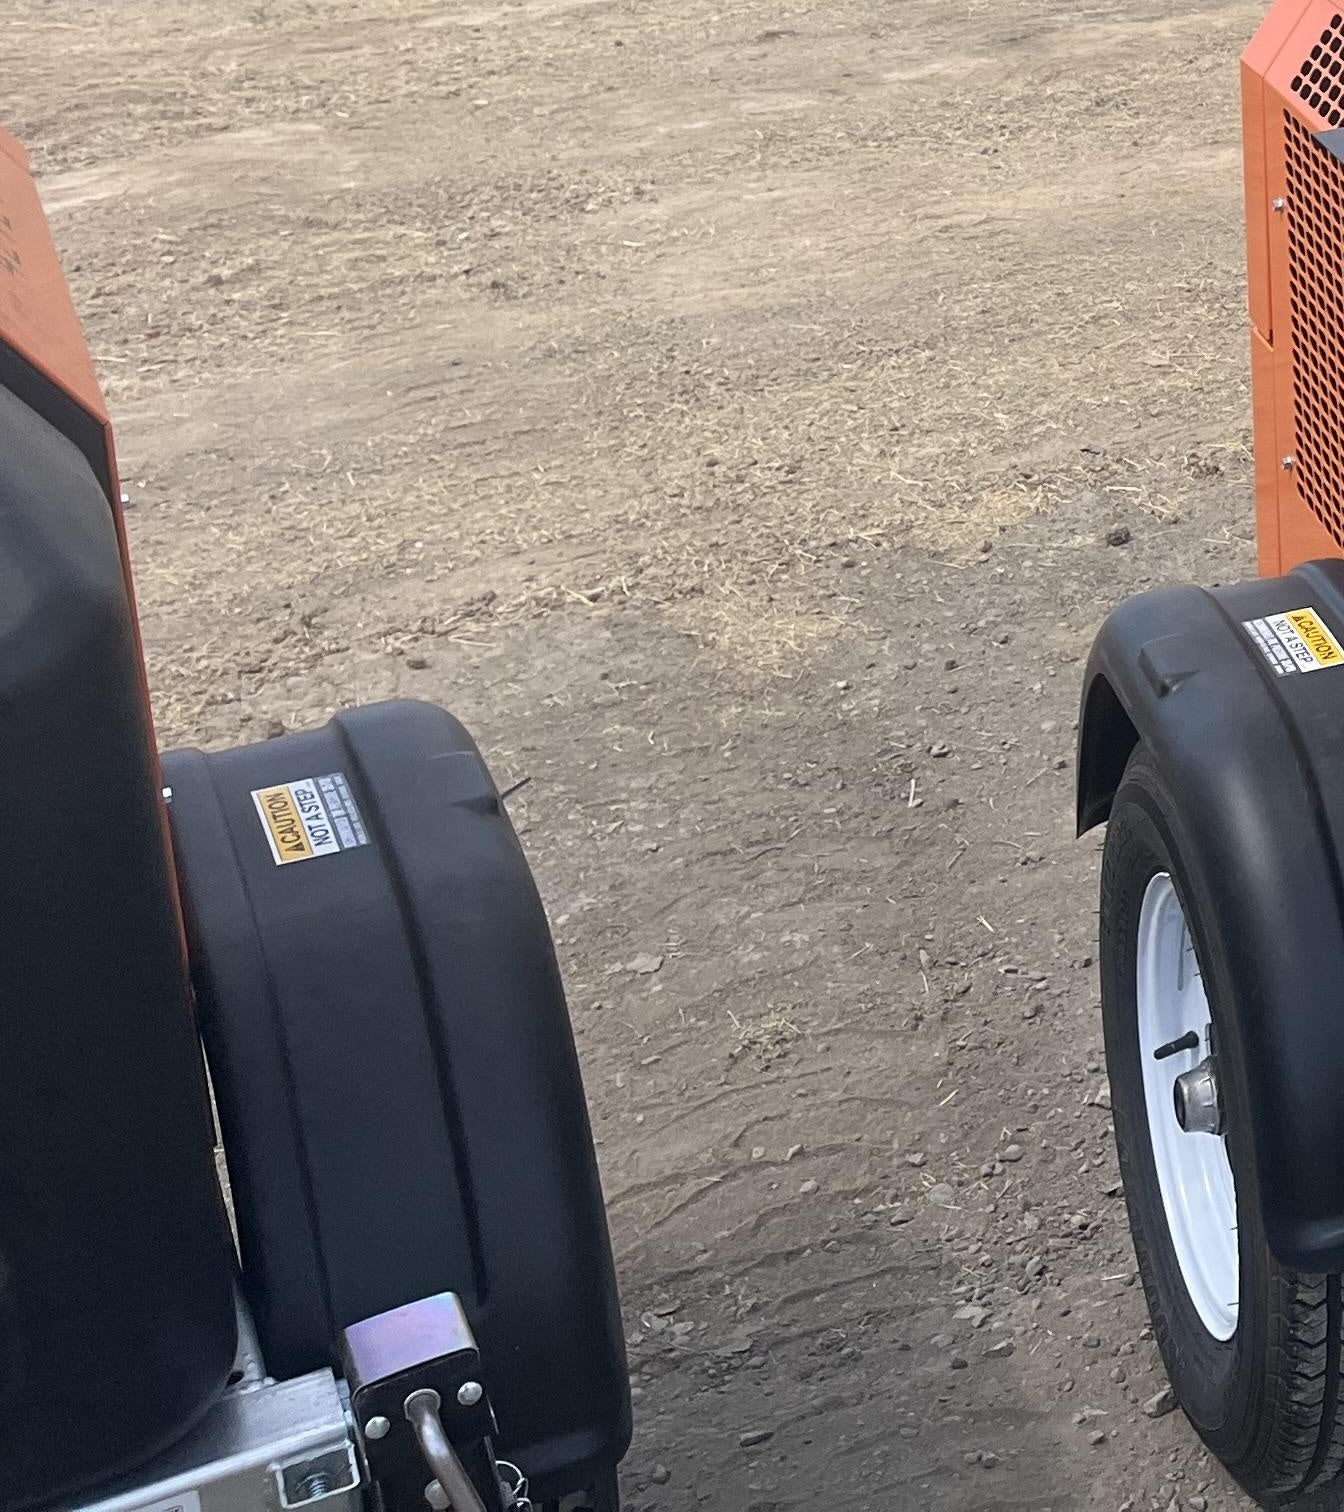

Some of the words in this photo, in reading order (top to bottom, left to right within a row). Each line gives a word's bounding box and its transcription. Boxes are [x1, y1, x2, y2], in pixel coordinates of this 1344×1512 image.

[1274, 620, 1295, 635] NOT
[1290, 642, 1314, 663] STEP
[1297, 619, 1339, 660] CAUTION
[295, 789, 320, 812] STEP
[265, 792, 302, 845] CAUTION
[305, 813, 323, 822] A
[308, 824, 333, 847] NOT
